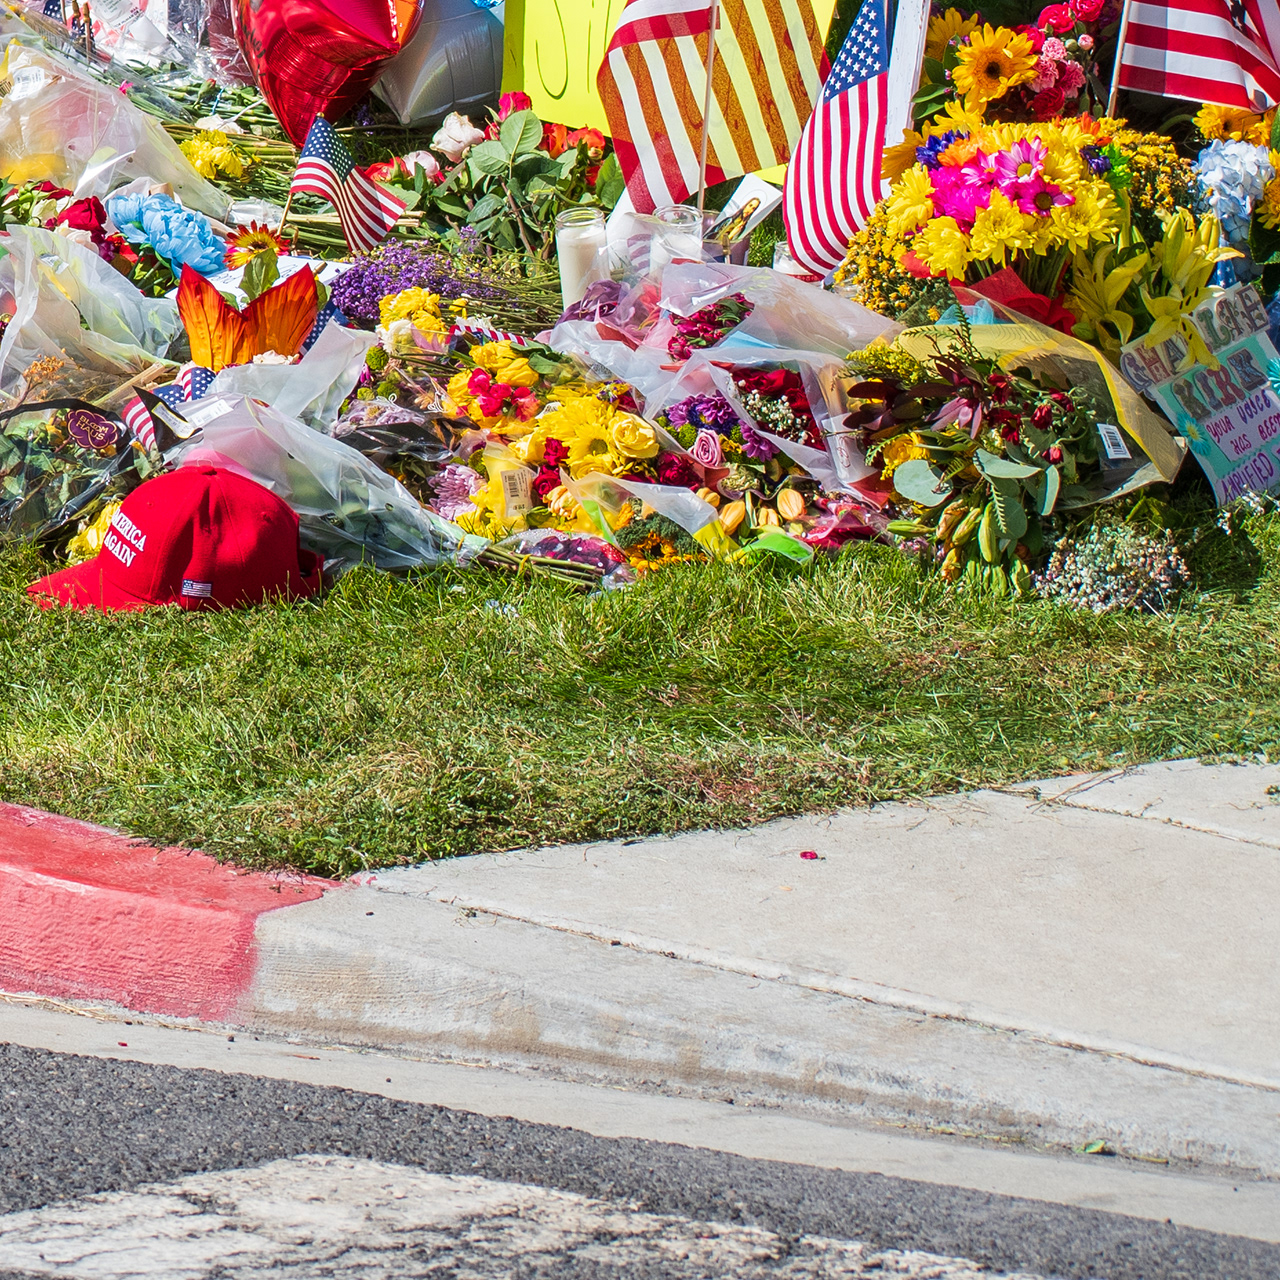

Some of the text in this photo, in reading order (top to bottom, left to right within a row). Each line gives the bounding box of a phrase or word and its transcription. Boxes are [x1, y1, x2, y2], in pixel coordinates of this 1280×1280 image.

[1120, 283, 1270, 401] CHALIE
[1170, 347, 1271, 422] KIRK
[75, 420, 106, 442] HAUS
[78, 414, 109, 435] BLOOM
[103, 531, 137, 569] AGAIN
